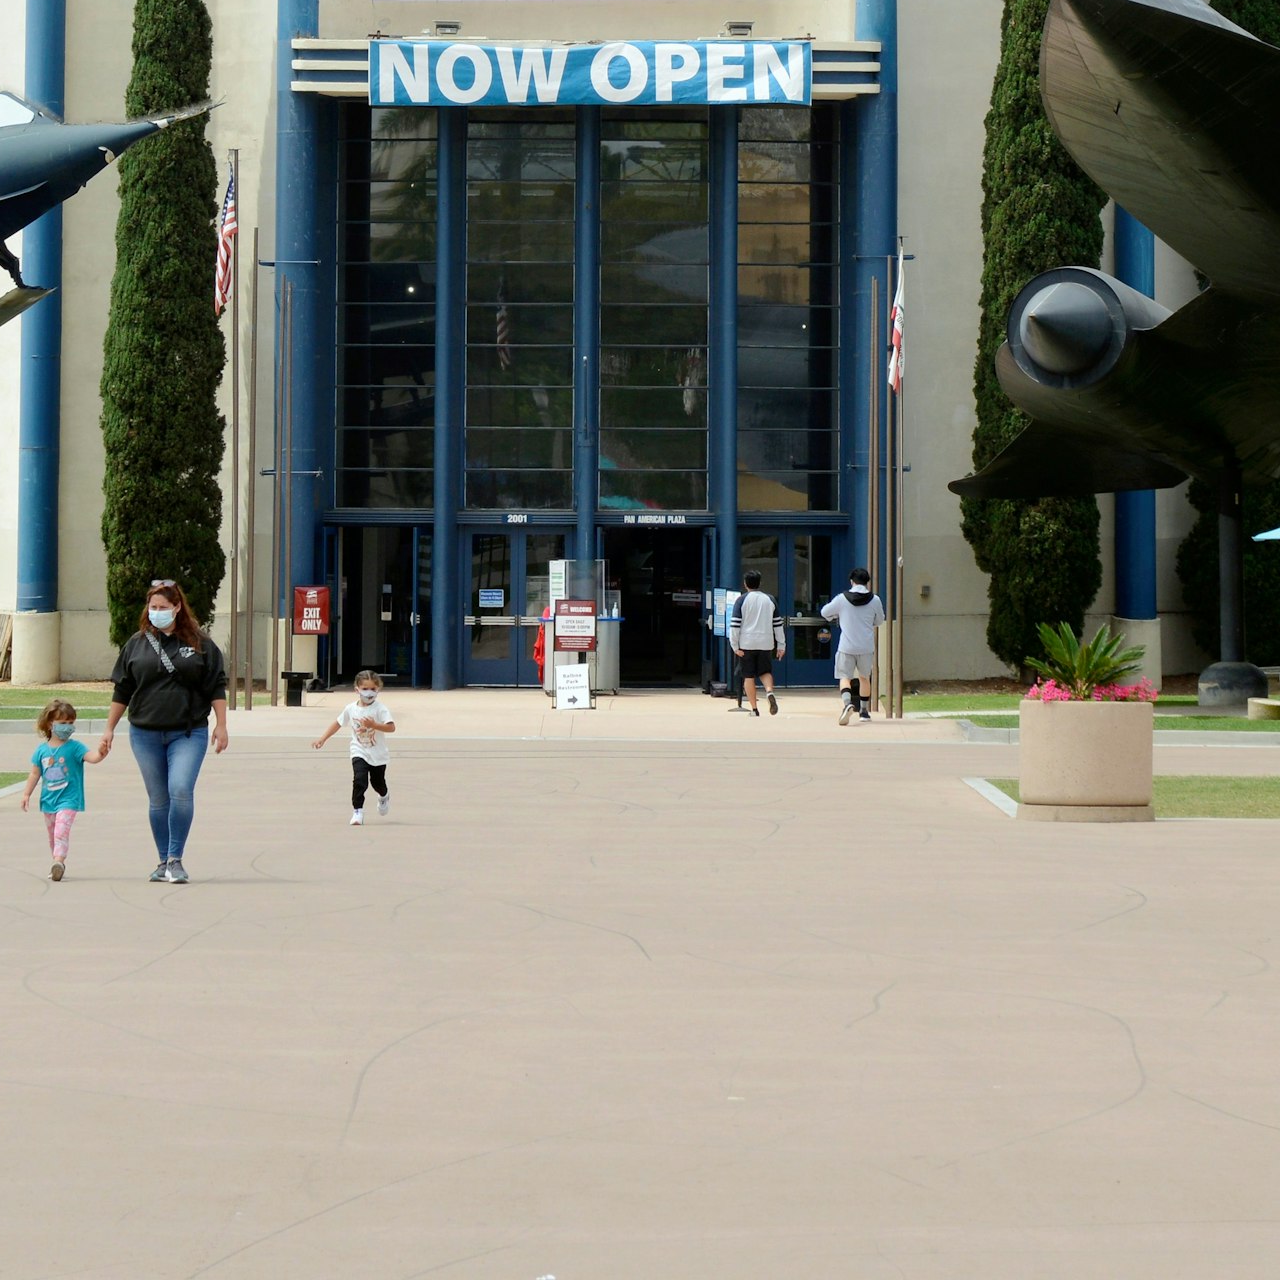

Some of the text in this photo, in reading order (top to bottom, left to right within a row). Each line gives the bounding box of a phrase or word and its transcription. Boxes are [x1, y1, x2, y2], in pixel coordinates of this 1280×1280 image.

[378, 42, 803, 104] NOW OPEN
[507, 514, 527, 523] 2001
[624, 515, 686, 524] PAN AMERICAN PLAZA
[303, 608, 320, 619] EXIT
[301, 619, 322, 631] ONLY
